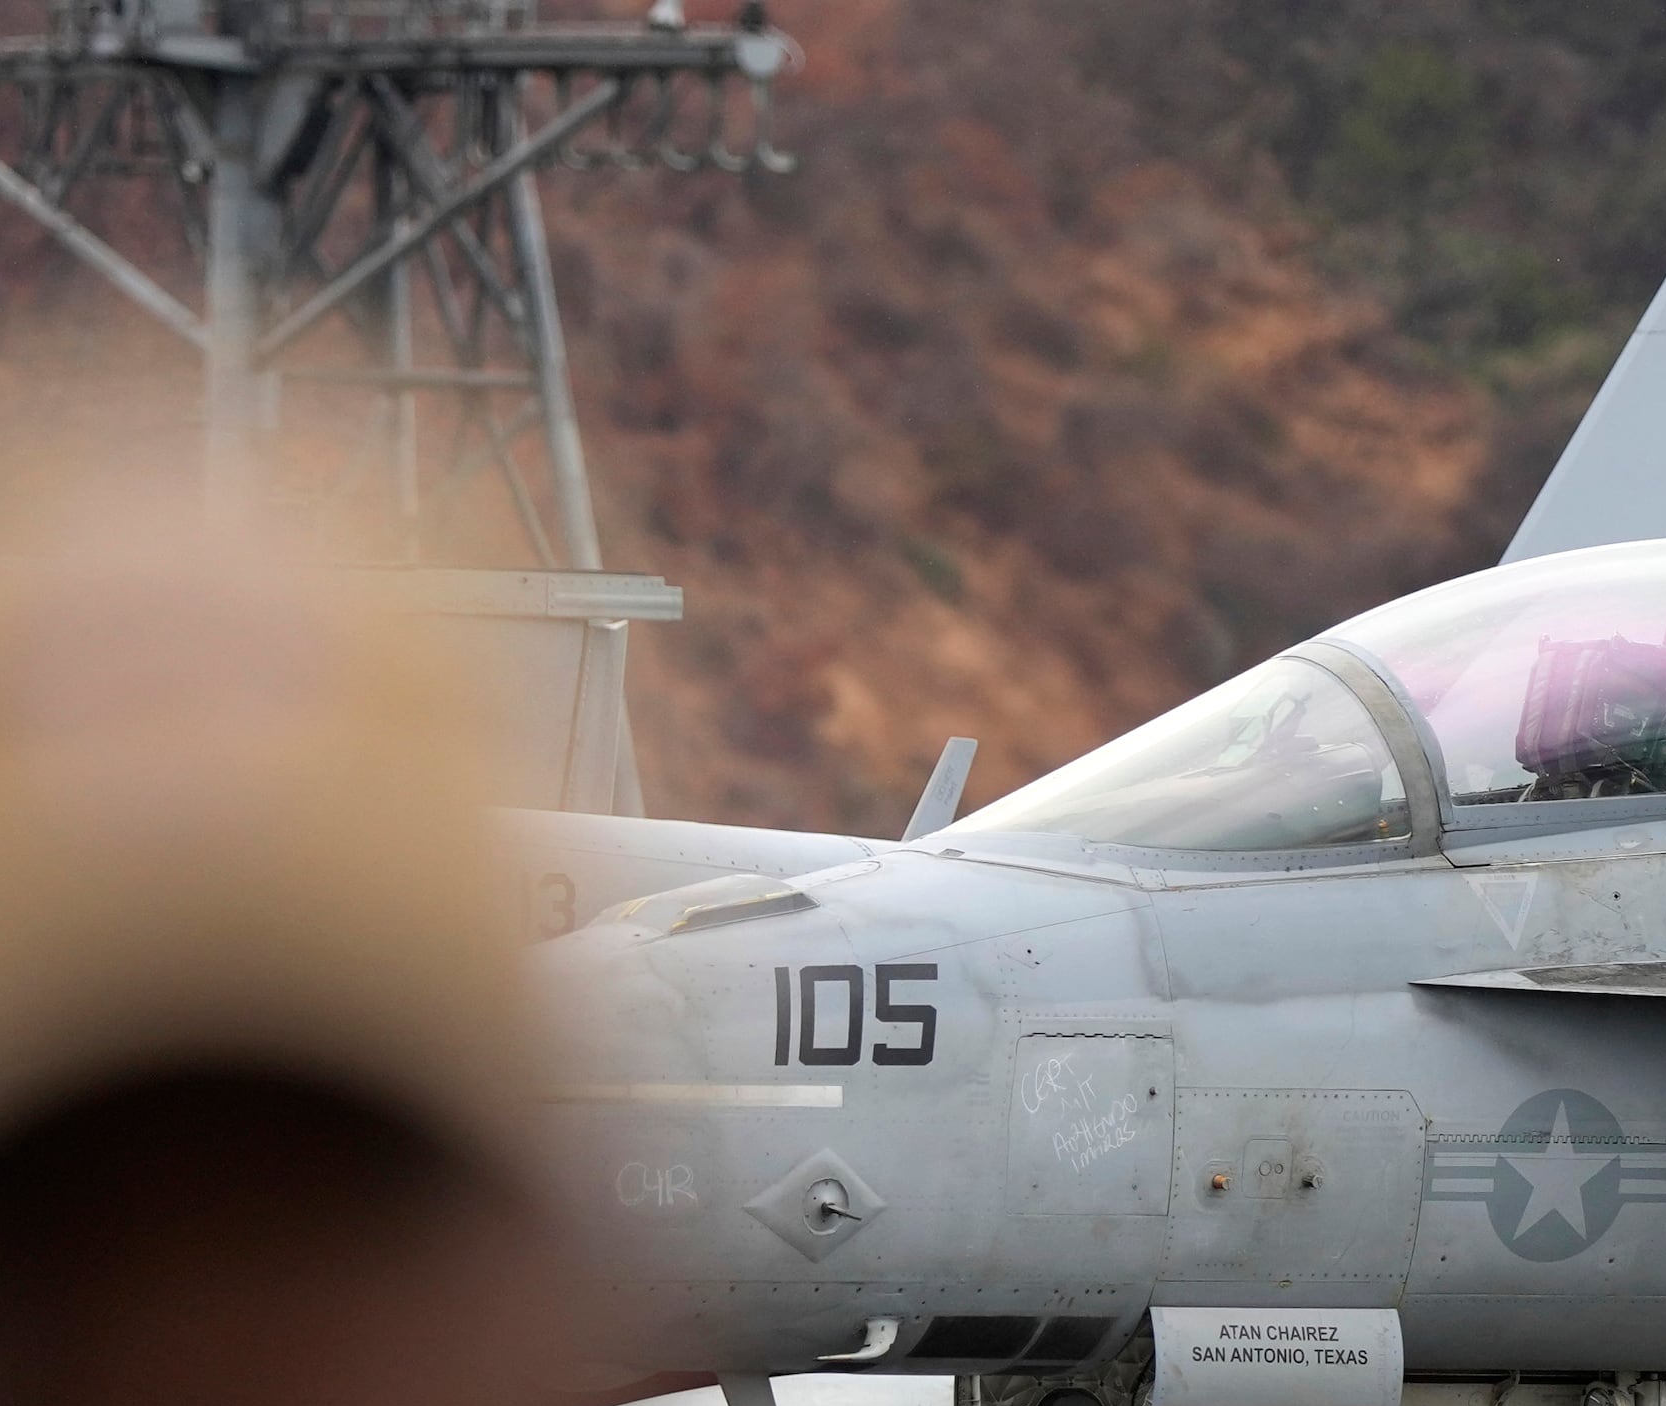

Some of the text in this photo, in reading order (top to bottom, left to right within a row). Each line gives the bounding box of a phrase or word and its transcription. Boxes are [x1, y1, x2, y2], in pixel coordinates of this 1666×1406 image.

[773, 963, 940, 1067] 105
[1342, 1110, 1401, 1122] CAUTION
[1218, 1324, 1340, 1342] ATAN CHAIREZ
[1191, 1347, 1369, 1368] SAN ANTONIO, TEXAS
